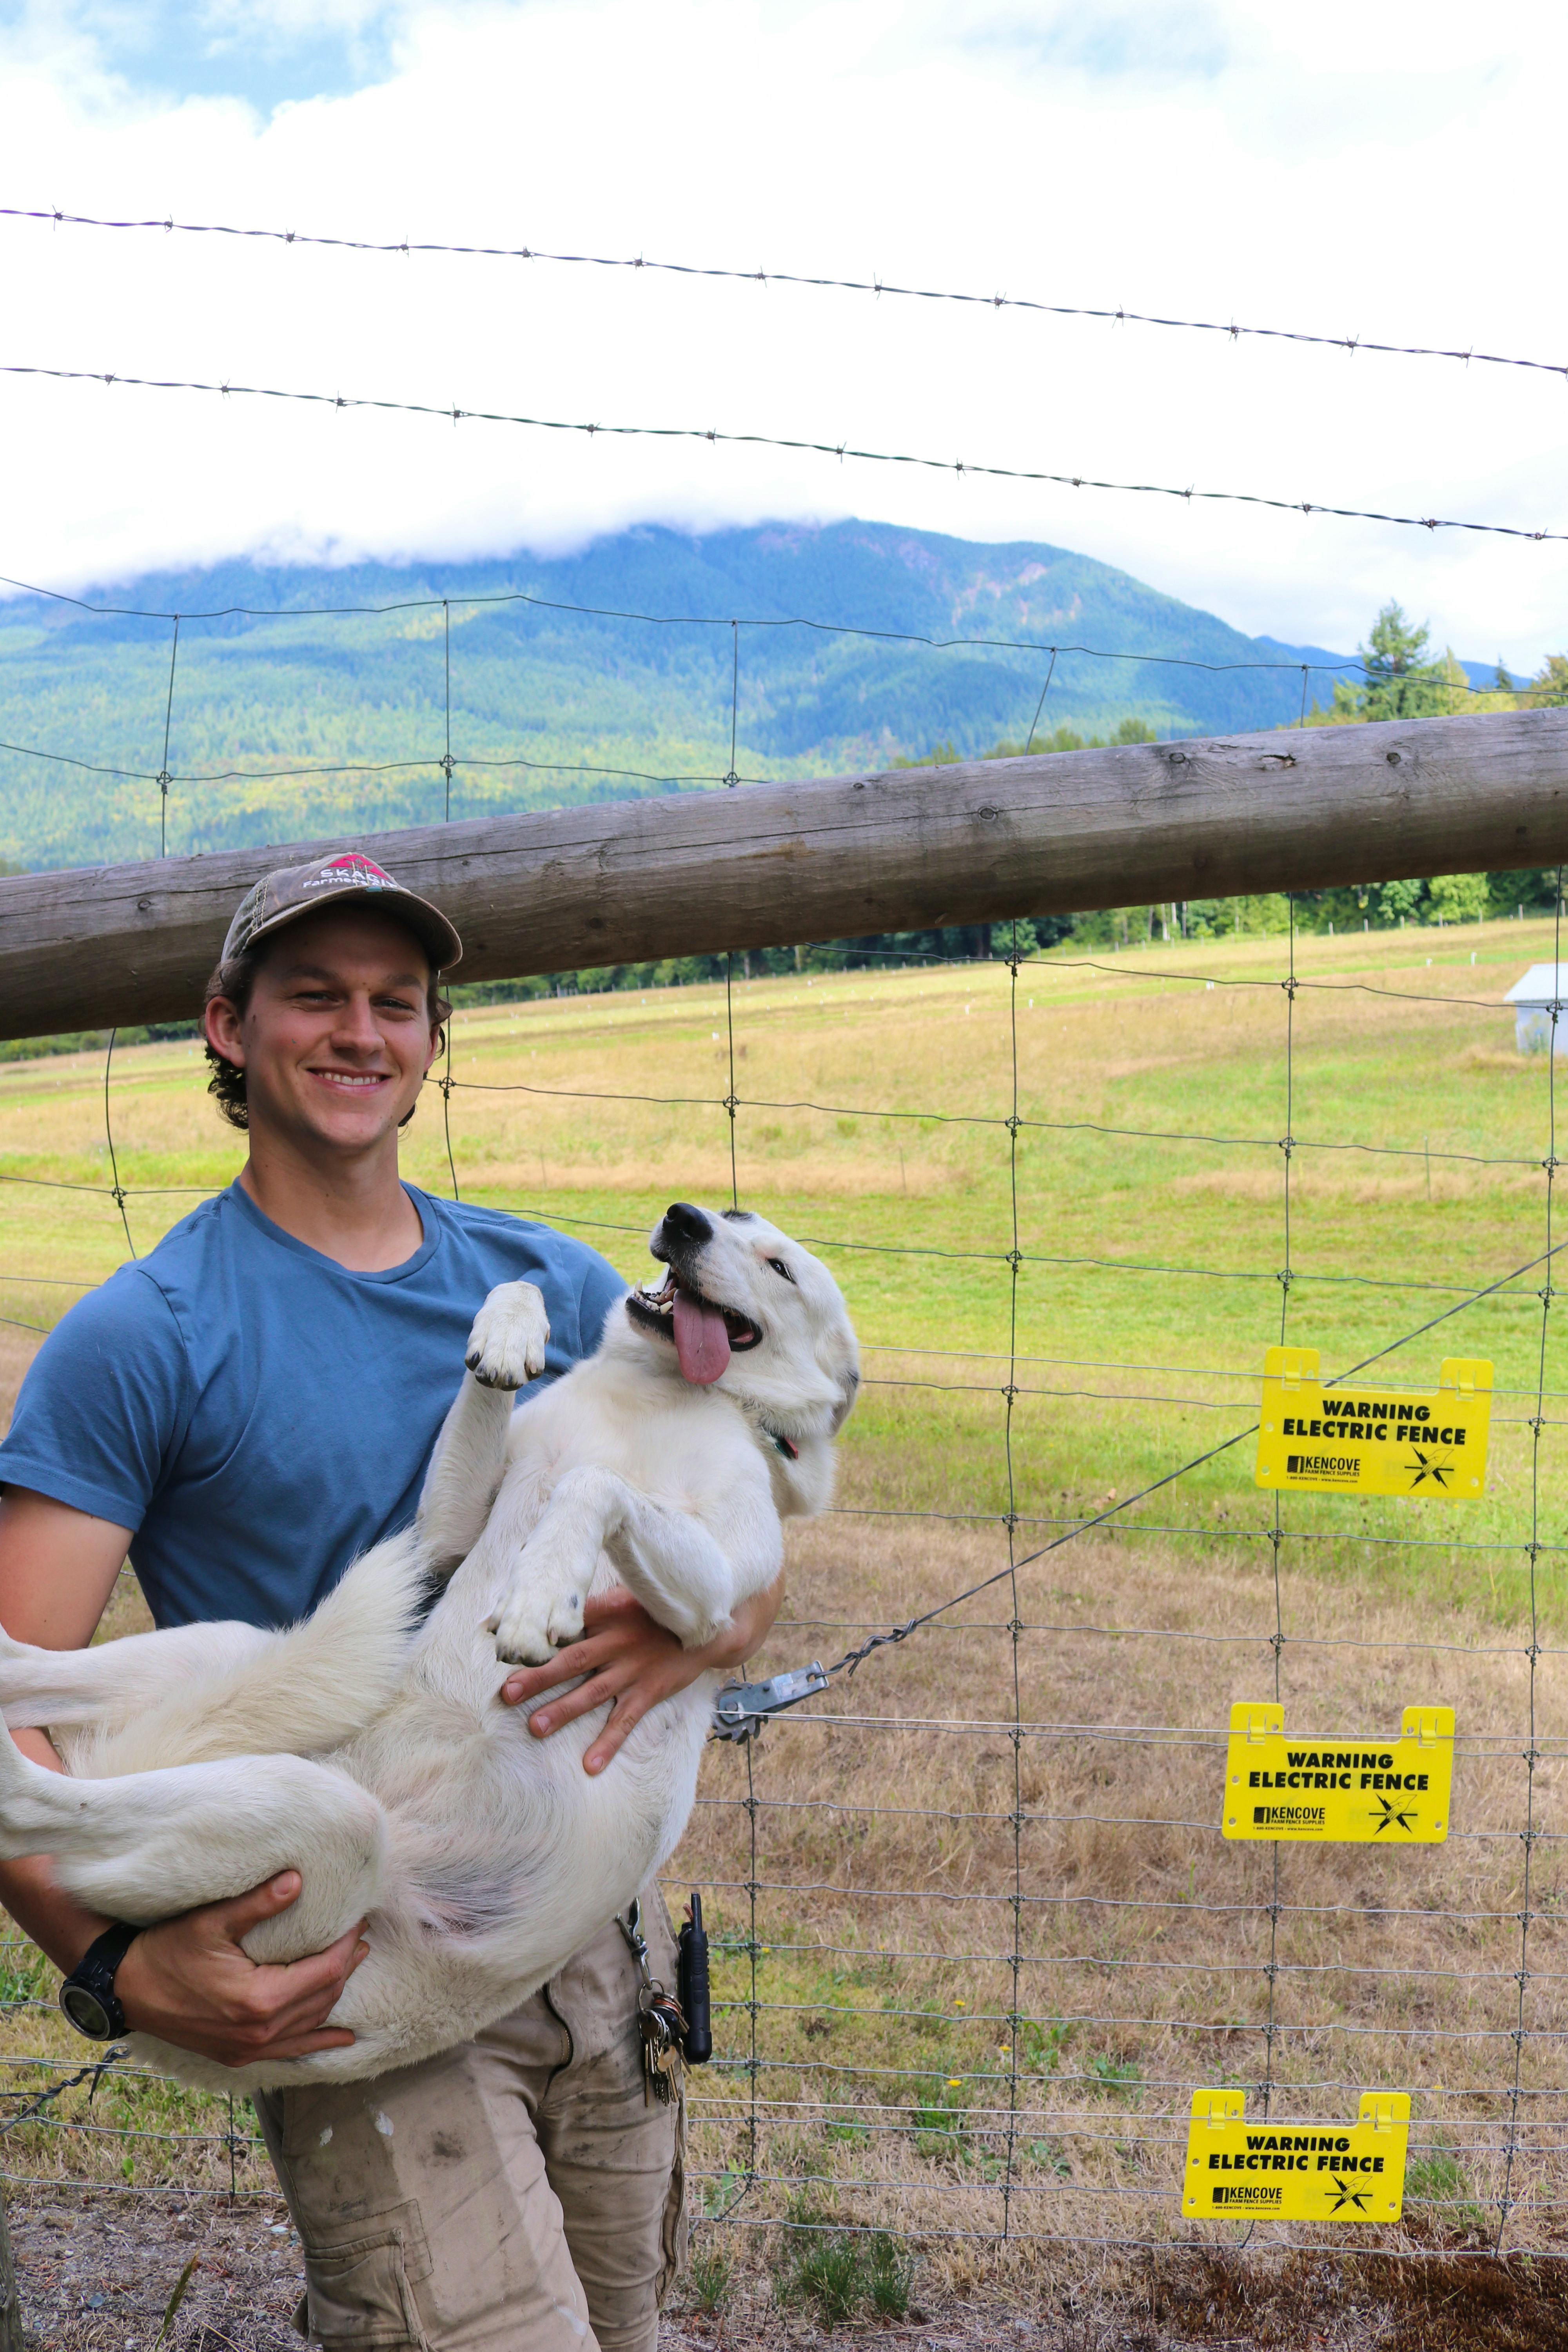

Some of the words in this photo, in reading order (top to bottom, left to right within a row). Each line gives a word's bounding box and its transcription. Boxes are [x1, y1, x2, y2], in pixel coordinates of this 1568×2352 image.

[320, 868, 397, 888] SKAGIT
[1323, 1400, 1430, 1421] WARNING
[1283, 1419, 1387, 1441] ELECTRIC
[1397, 1425, 1466, 1445] FENCE
[1306, 1456, 1361, 1471] KENCOVE
[1288, 1752, 1394, 1769] WARNING
[1249, 1772, 1351, 1789] ELECTRIC
[1360, 1773, 1428, 1791] FENCE
[1272, 1807, 1325, 1819] KENCOVE
[1247, 2136, 1350, 2151] WARNING
[1209, 2154, 1308, 2171] ELECTRIC
[1317, 2156, 1384, 2172] FENCE
[1230, 2187, 1282, 2199] KENCOVE
